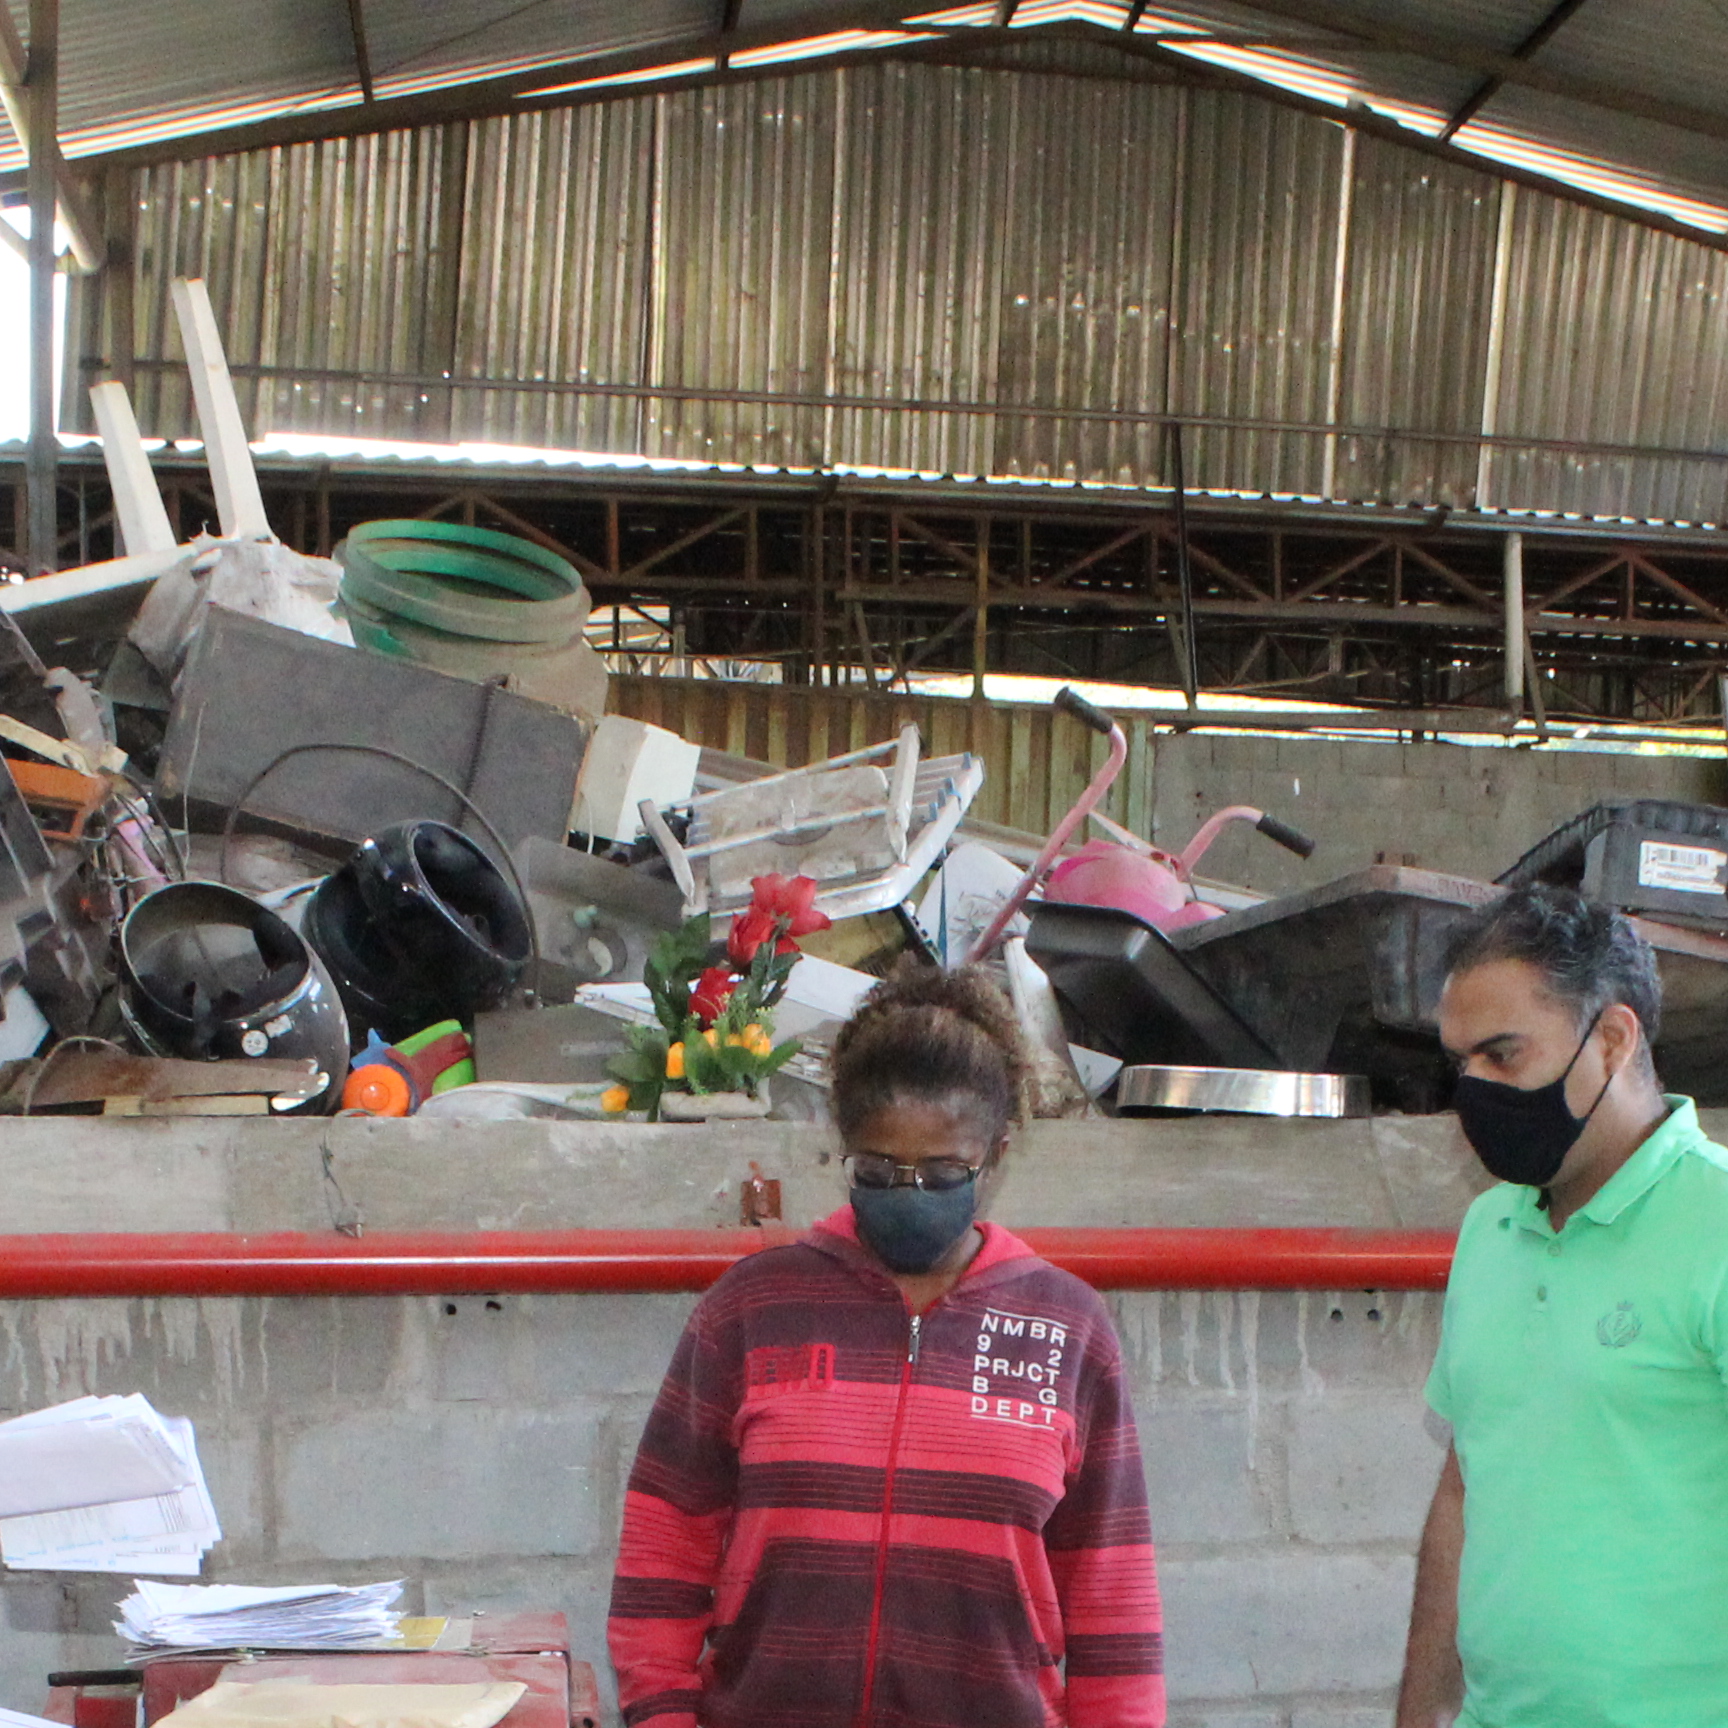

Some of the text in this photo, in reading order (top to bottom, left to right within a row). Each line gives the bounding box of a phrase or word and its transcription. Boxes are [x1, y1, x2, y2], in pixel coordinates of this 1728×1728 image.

[981, 1312, 1067, 1348] NMBR
[977, 1334, 1062, 1367] 9 2
[974, 1354, 1061, 1386] PRJCT
[972, 1375, 1058, 1406] B G
[971, 1396, 1057, 1424] DEPT
